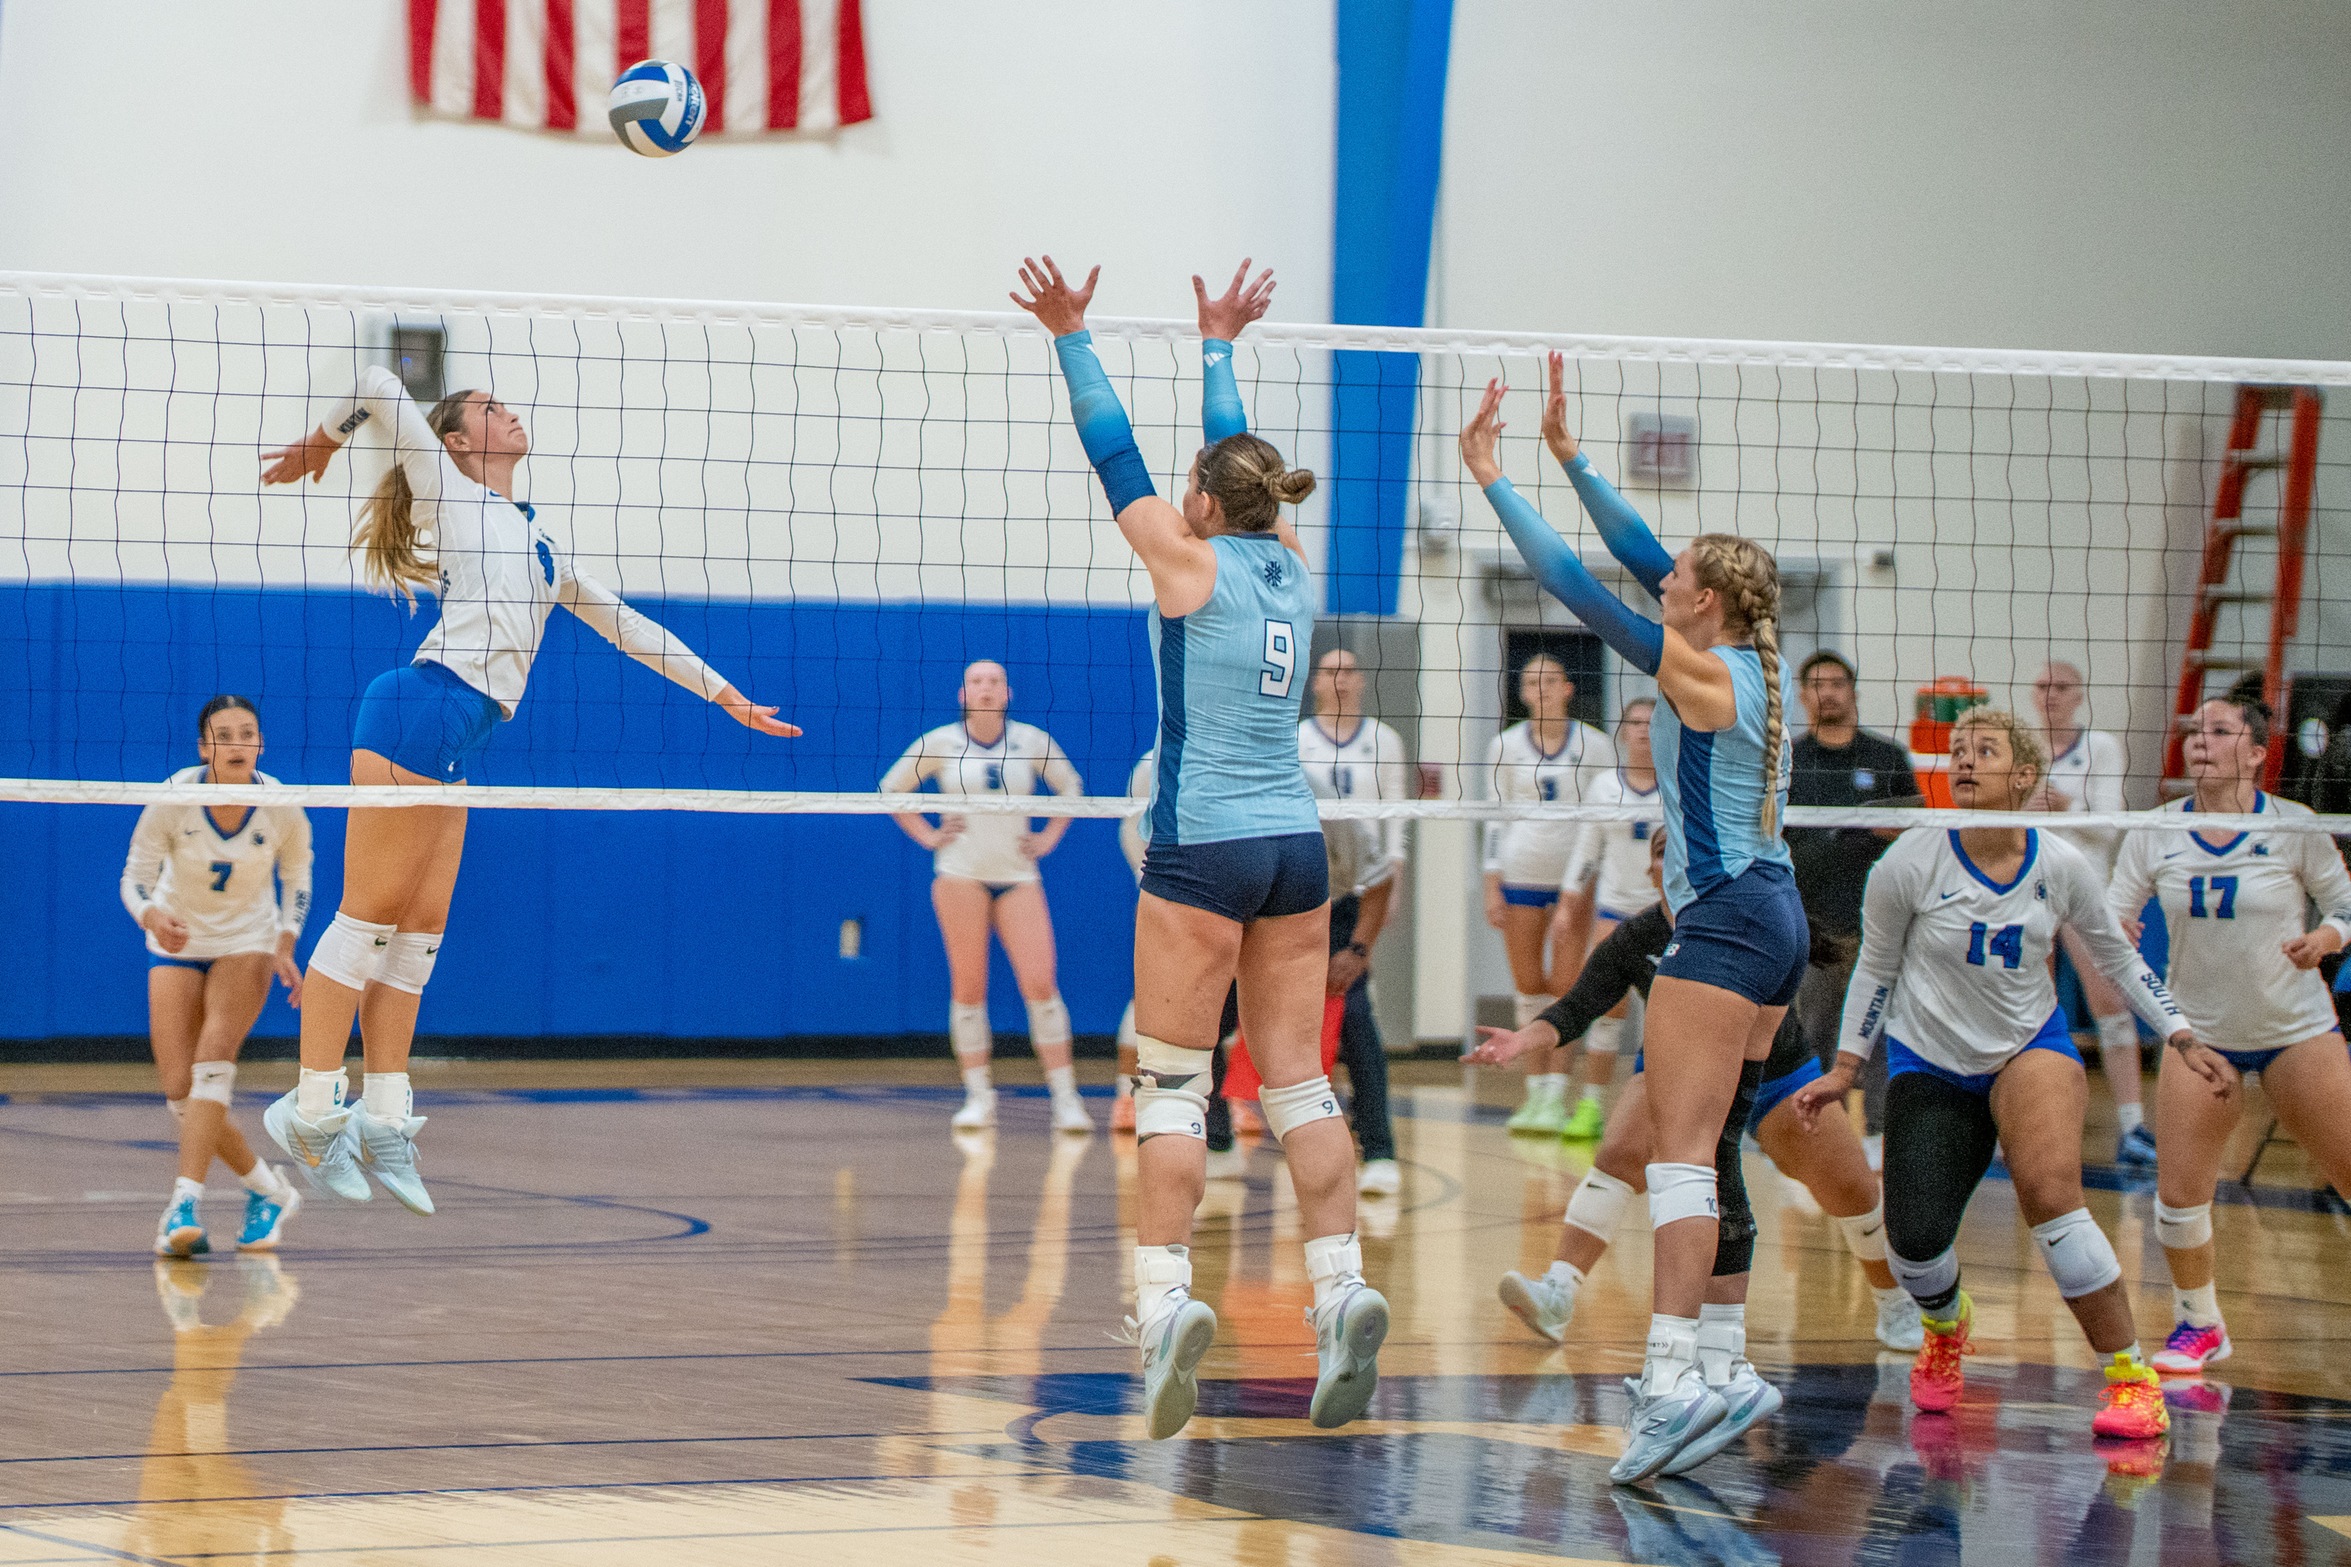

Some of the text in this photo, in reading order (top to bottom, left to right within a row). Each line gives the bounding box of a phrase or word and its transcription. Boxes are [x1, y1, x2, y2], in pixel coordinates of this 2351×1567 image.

[1258, 618, 1296, 699] 9
[209, 862, 233, 892] 7
[2188, 875, 2238, 919] 17
[1966, 921, 2024, 969] 14
[1857, 985, 1888, 1039] MOUNTAIN
[2140, 973, 2181, 1016] SOUTH
[1190, 1121, 1202, 1135] 9
[1322, 1099, 1334, 1114] 9
